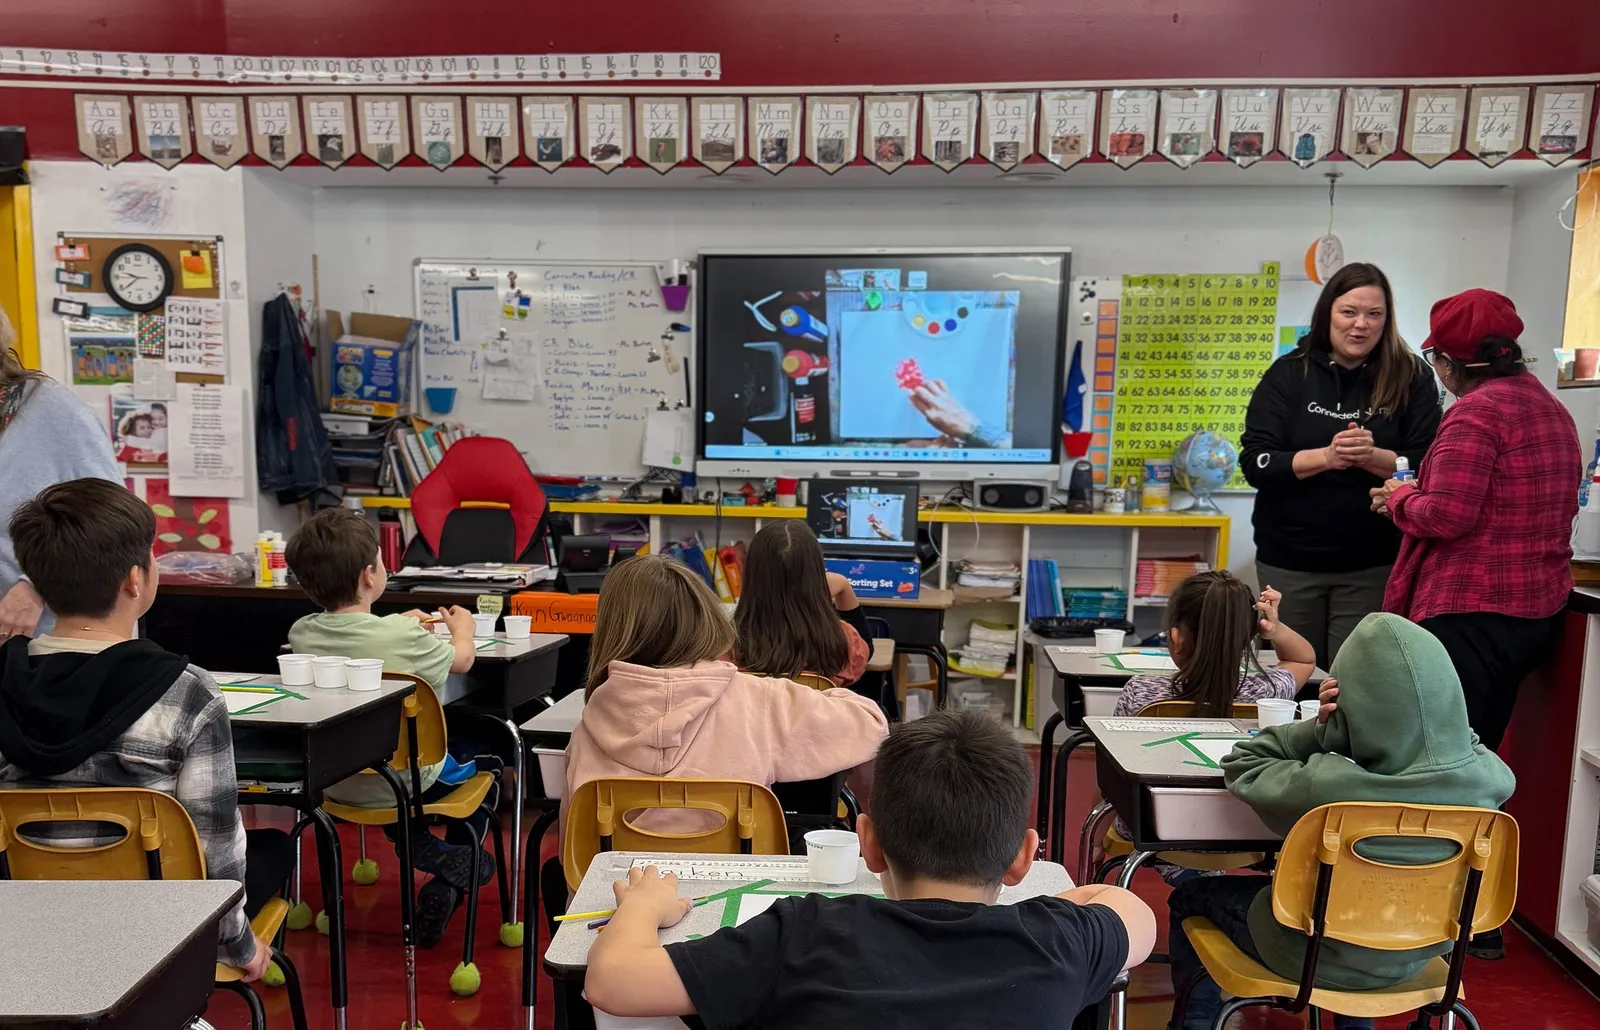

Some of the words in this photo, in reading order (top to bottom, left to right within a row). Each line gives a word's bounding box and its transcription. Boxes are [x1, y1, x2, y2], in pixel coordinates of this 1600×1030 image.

[1142, 278, 1149, 288] 2
[1157, 278, 1164, 288] 3
[1173, 278, 1180, 288] 4
[1188, 278, 1195, 288] 5
[1204, 279, 1211, 288] 6
[1220, 278, 1227, 288] 7
[1235, 279, 1242, 288] 8
[1252, 278, 1258, 288] 9
[1266, 278, 1276, 288] 10
[1139, 297, 1149, 307] 12
[1170, 297, 1180, 306] 14
[1186, 296, 1196, 307] 15
[1202, 297, 1212, 307] 16
[1218, 297, 1227, 306] 17
[1233, 297, 1243, 306] 18
[1249, 297, 1259, 306] 19
[1263, 296, 1276, 306] 20
[1122, 315, 1132, 325] 21
[1136, 315, 1149, 325] 22
[1152, 315, 1165, 325] 23
[1168, 315, 1180, 324] 24
[1183, 315, 1196, 324] 25
[1199, 315, 1212, 325] 26
[1215, 315, 1227, 325] 27
[1230, 315, 1243, 324] 28
[1246, 315, 1259, 324] 29
[1261, 314, 1275, 325] 30
[1121, 333, 1131, 343] 31
[1135, 333, 1148, 343] 32
[1151, 333, 1164, 343] 33
[1166, 333, 1179, 343] 34
[1181, 333, 1195, 343] 35
[1198, 333, 1210, 343] 36
[1213, 333, 1226, 343] 37
[1228, 333, 1242, 343] 38
[1244, 333, 1257, 343] 39
[1259, 333, 1273, 343] 40
[1120, 351, 1130, 360] 41
[1134, 351, 1147, 361] 42
[1149, 351, 1162, 360] 43
[1165, 351, 1178, 360] 44
[1180, 351, 1193, 360] 45
[1196, 351, 1209, 360] 46
[1212, 351, 1225, 360] 47
[1227, 351, 1240, 360] 48
[1243, 351, 1256, 360] 49
[1258, 351, 1272, 361] 50
[1119, 369, 1128, 379] 51
[1134, 369, 1146, 379] 52
[1148, 369, 1161, 379] 53
[1164, 369, 1177, 378] 54
[1180, 369, 1192, 379] 55
[1195, 369, 1208, 379] 56
[1211, 369, 1224, 379] 57
[1226, 369, 1239, 379] 58
[1242, 369, 1255, 379] 59
[1118, 387, 1127, 396] 61
[1131, 387, 1144, 396] 62
[1147, 387, 1160, 396] 63
[1162, 387, 1175, 396] 64
[1178, 387, 1191, 396] 65
[1194, 387, 1207, 396] 66
[1209, 387, 1222, 396] 67
[1224, 387, 1238, 396] 68
[1240, 387, 1253, 397] 69
[1117, 404, 1126, 414] 71
[1132, 404, 1143, 414] 72
[1146, 404, 1159, 414] 73
[1163, 405, 1173, 414] 74
[1178, 404, 1190, 414] 75
[1194, 404, 1205, 414] 76
[1208, 404, 1221, 414] 77
[1224, 405, 1236, 414] 78
[1308, 402, 1360, 420] Connected
[847, 578, 878, 588] Sorting
